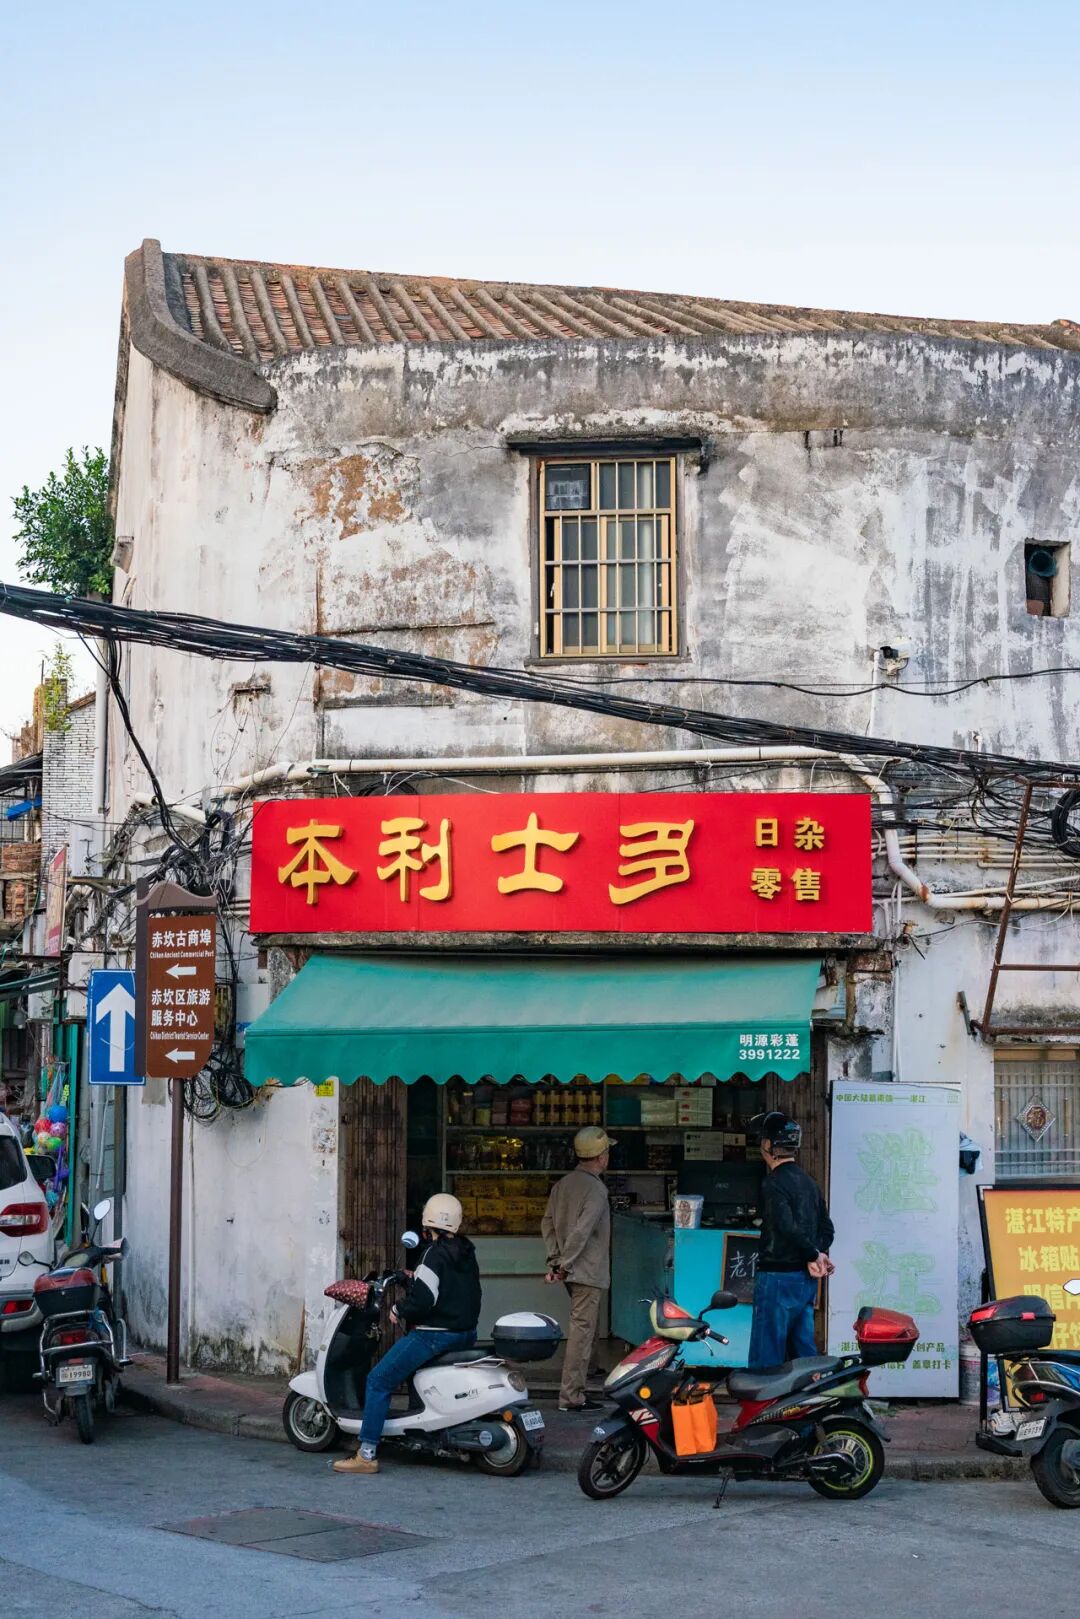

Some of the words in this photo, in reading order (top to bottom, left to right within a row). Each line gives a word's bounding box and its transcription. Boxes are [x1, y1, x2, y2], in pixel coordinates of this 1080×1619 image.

[755, 816, 826, 851] 日杂
[277, 812, 695, 905] 本利士多
[750, 867, 822, 902] 零售
[151, 928, 212, 948] 赤坎古商埠
[180, 950, 204, 958] Commercial
[151, 988, 211, 1006] 赤坎区旅游
[151, 1009, 198, 1027] 服务中心
[738, 1048, 801, 1060] 3991222
[1005, 1207, 1080, 1234] 湛江特产
[1018, 1245, 1080, 1272] 冰箱贴
